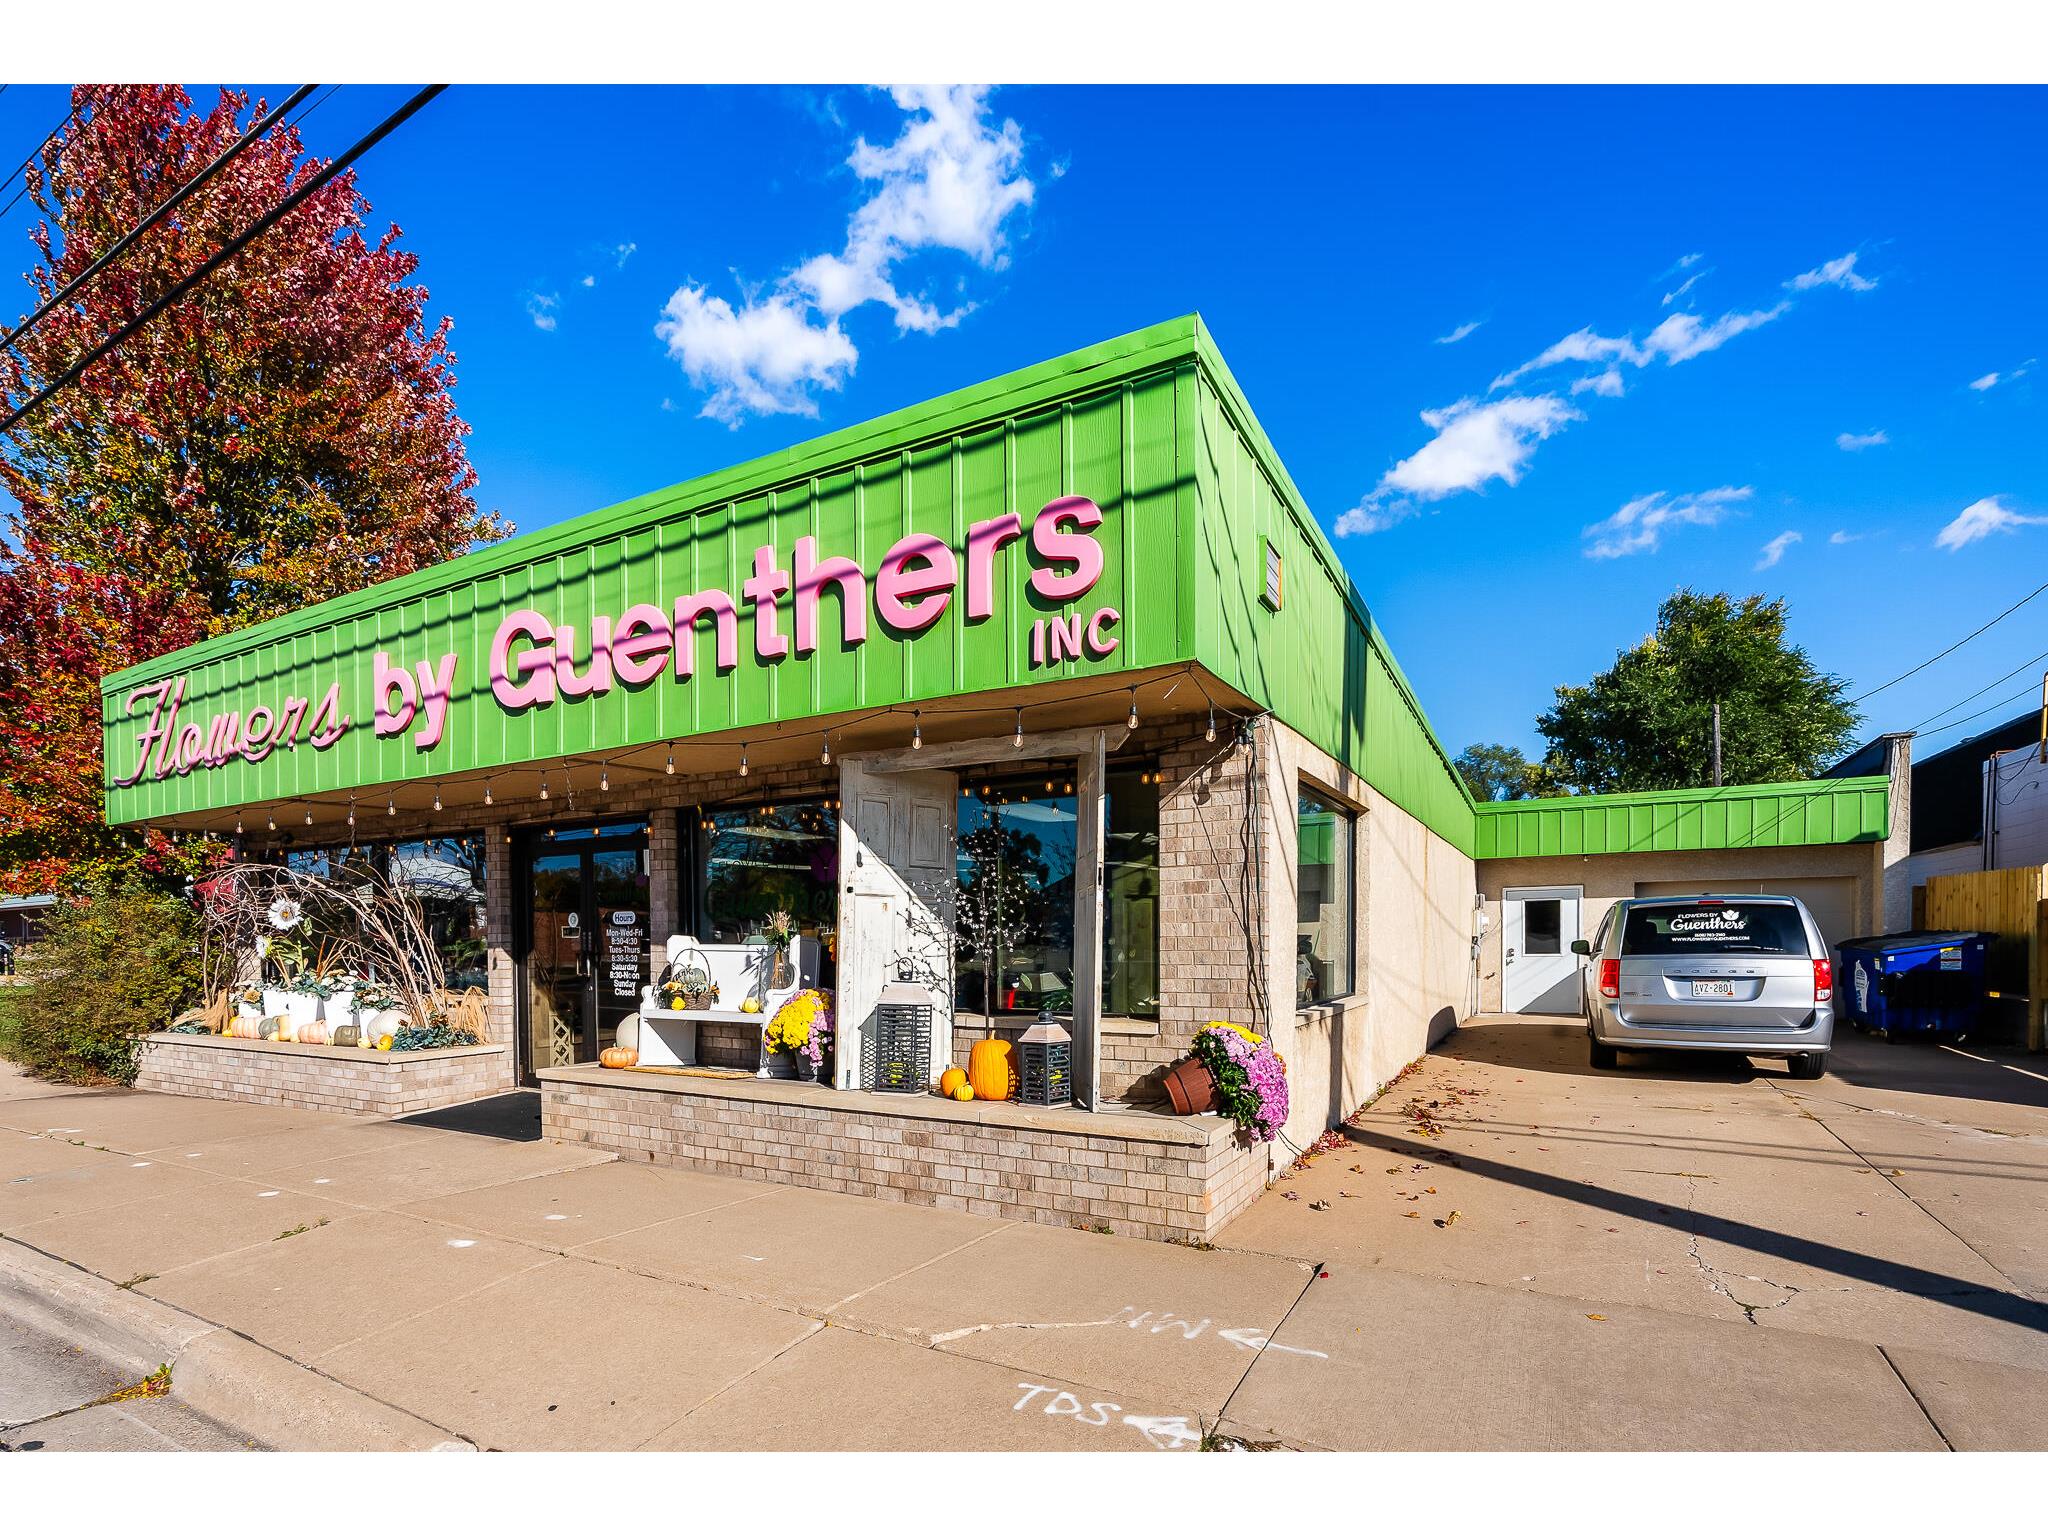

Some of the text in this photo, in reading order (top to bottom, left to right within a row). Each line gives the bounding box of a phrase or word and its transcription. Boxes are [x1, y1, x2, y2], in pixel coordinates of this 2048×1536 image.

[113, 495, 1104, 787] Flowers by Guenthers
[1032, 607, 1121, 667] INC
[614, 914, 633, 922] Hours
[1670, 917, 1747, 931] Guenthers
[606, 928, 643, 937] Mon-Wed-Fri
[611, 937, 638, 945] 8:30-4:30
[608, 945, 640, 954] Tues-Thurs
[611, 962, 638, 973] Saturday
[613, 979, 636, 990] Sunday
[614, 987, 636, 997] Closed
[1013, 1382, 1121, 1426] TDS
